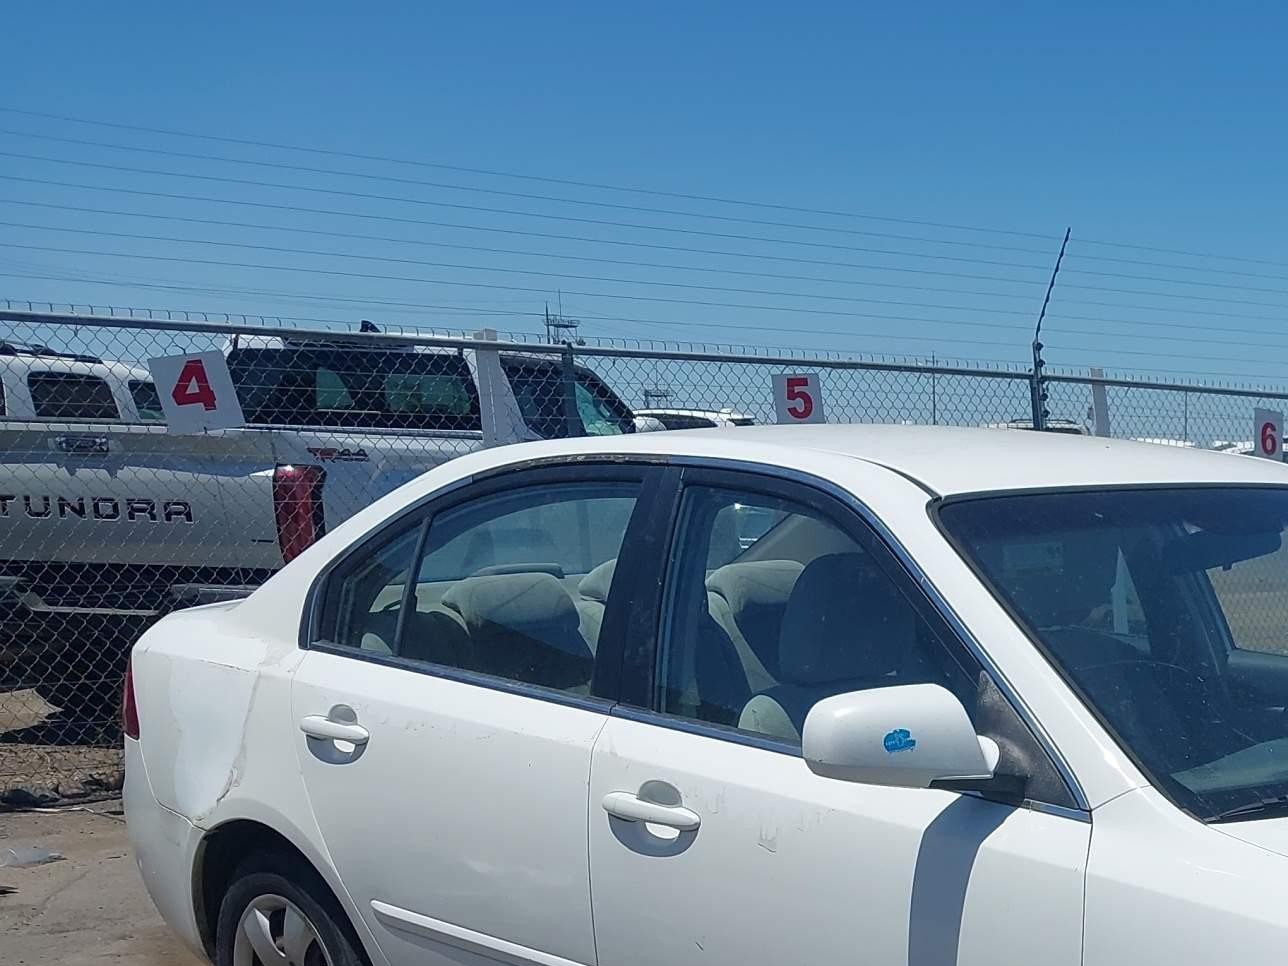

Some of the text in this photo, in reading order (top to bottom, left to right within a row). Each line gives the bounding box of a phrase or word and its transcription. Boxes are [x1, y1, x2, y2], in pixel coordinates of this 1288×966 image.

[171, 359, 217, 411] 4
[786, 377, 813, 419] 5
[1261, 422, 1277, 456] 6
[0, 495, 194, 524] TUNDRA
